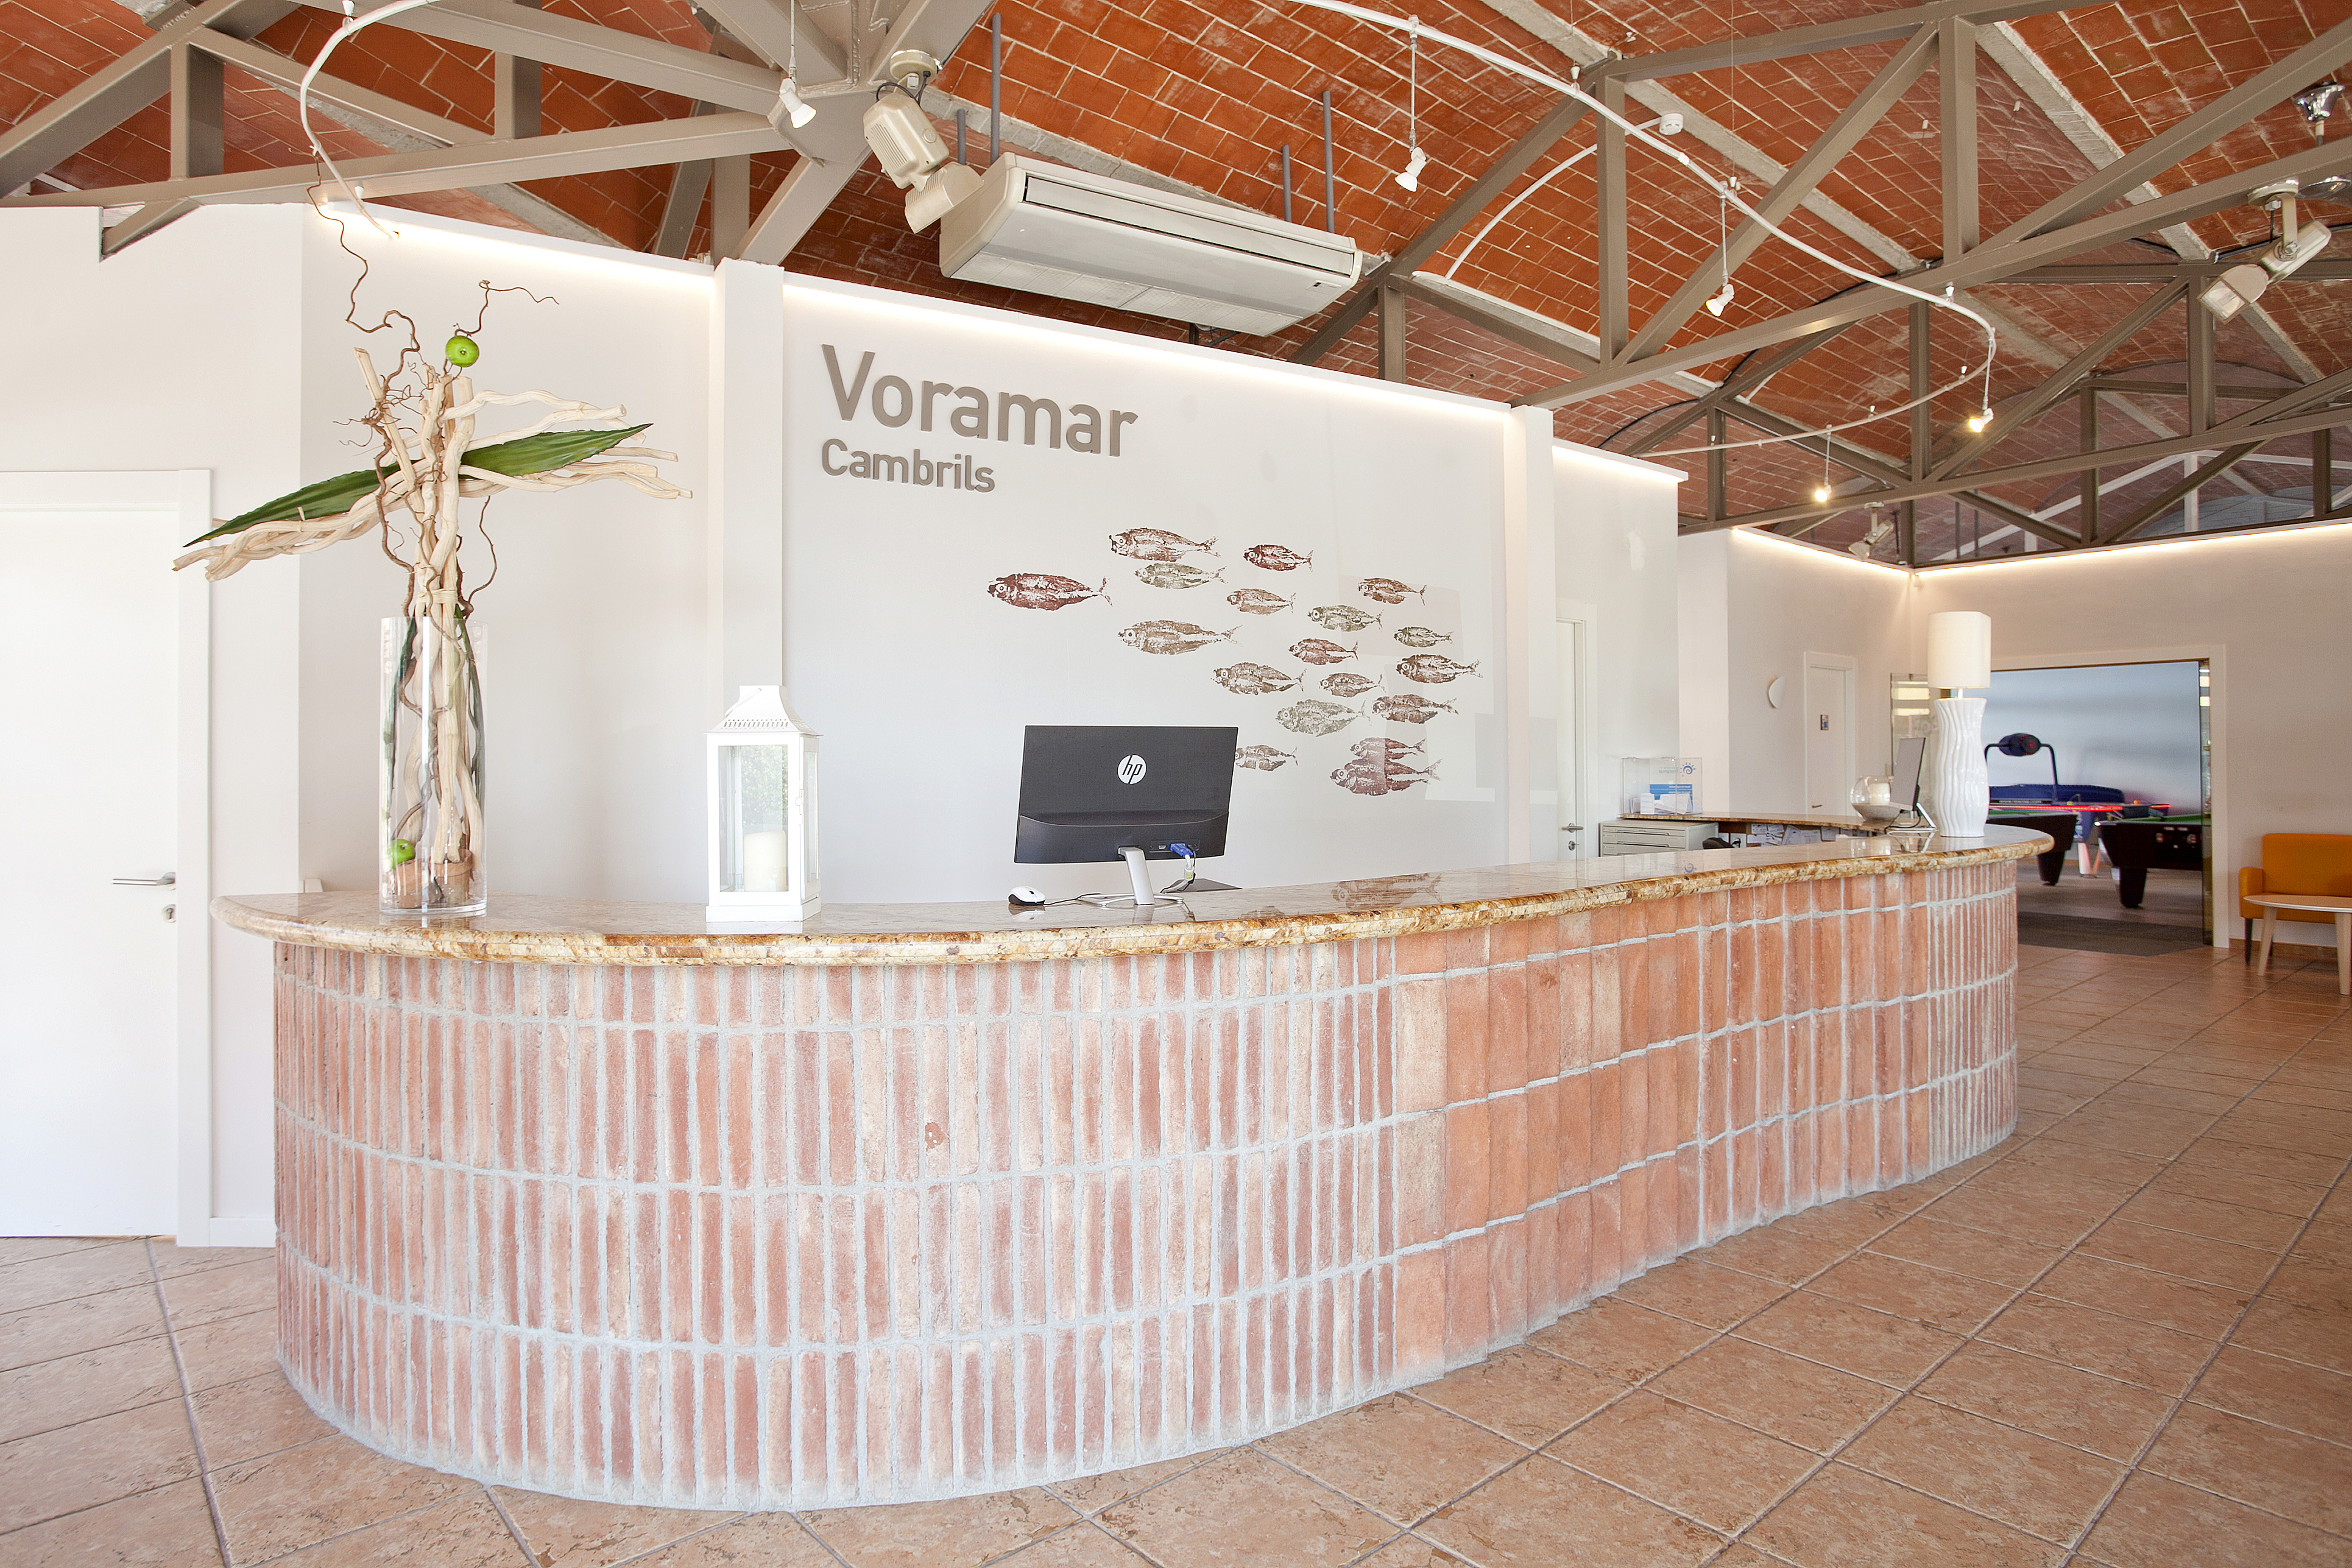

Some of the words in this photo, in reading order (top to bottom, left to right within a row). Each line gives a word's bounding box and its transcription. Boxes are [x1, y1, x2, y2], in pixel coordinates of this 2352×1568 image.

[822, 344, 1138, 456] Voramar
[822, 439, 995, 492] Cambrils
[1121, 754, 1143, 784] hp
